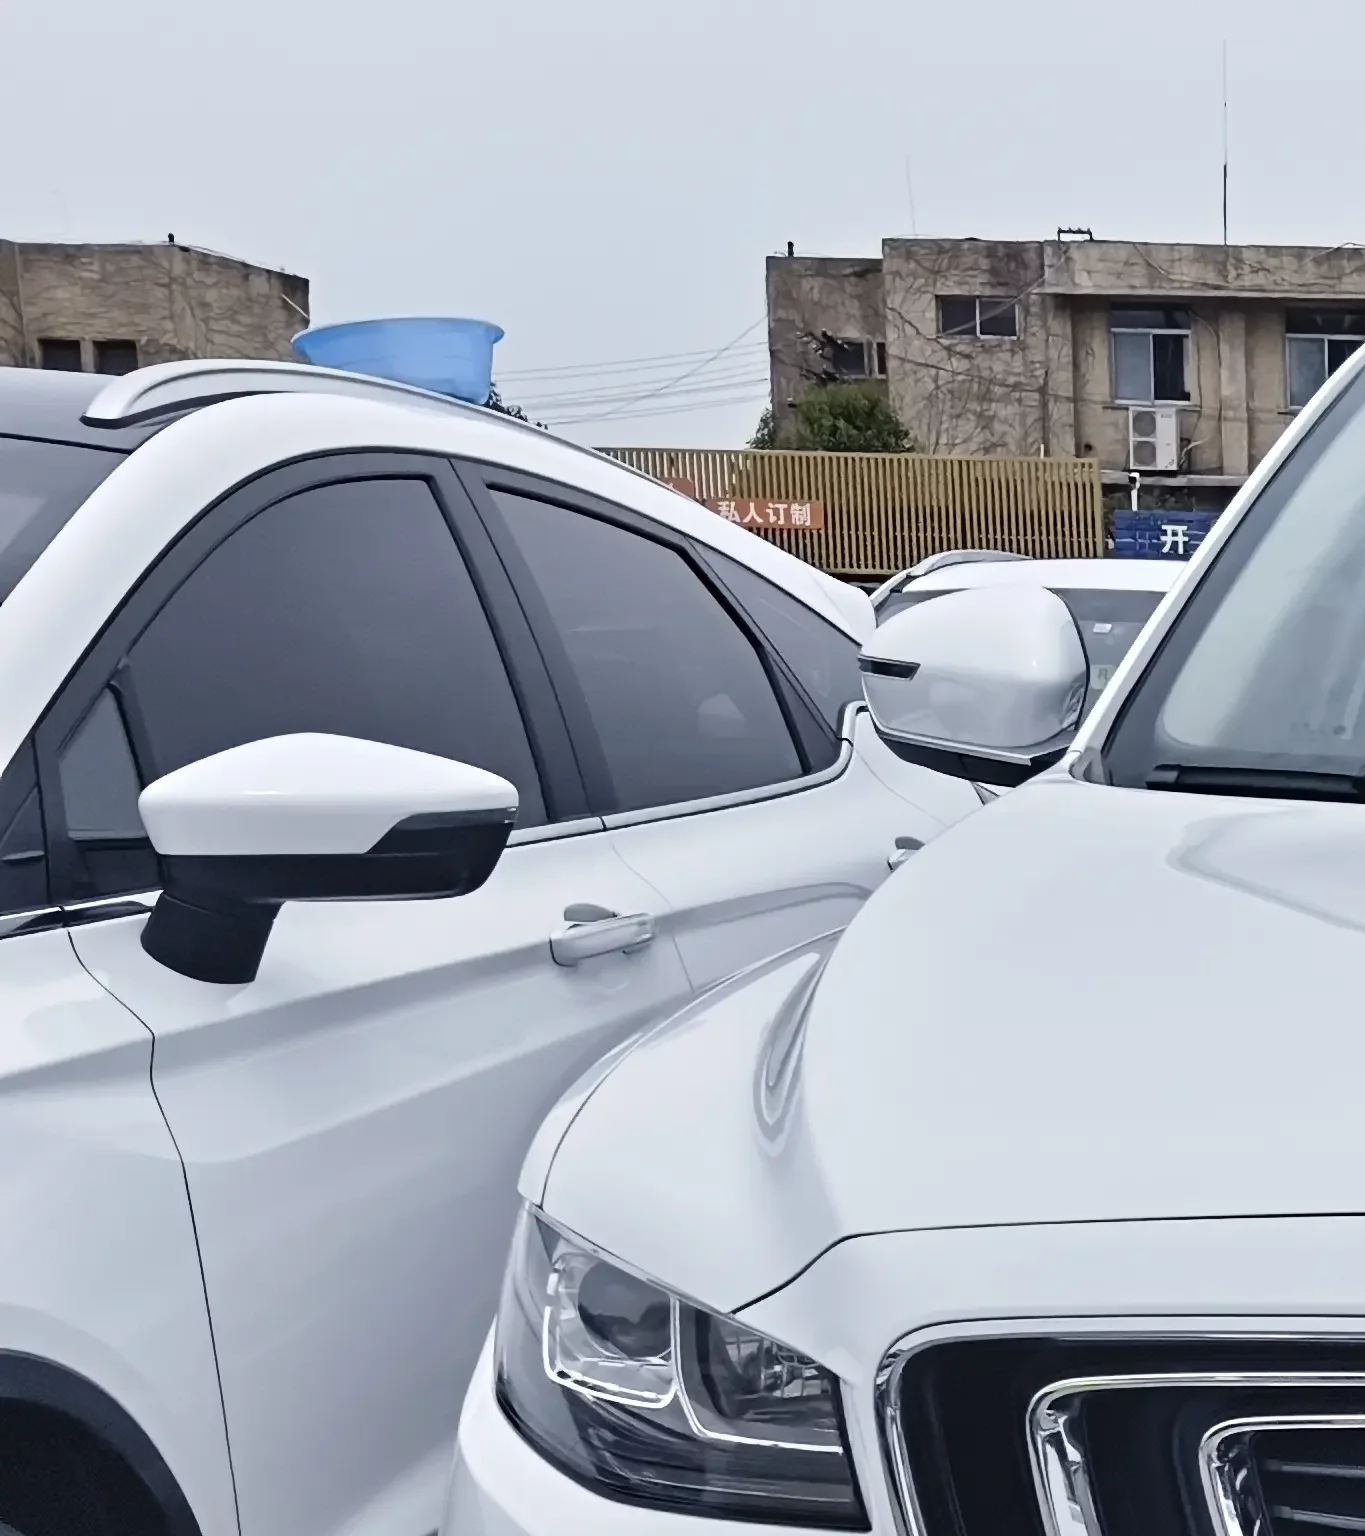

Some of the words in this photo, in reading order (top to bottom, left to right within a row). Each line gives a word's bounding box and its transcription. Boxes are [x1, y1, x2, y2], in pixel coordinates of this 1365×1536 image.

[716, 501, 811, 526] 私人订制
[1160, 524, 1190, 554] 开
